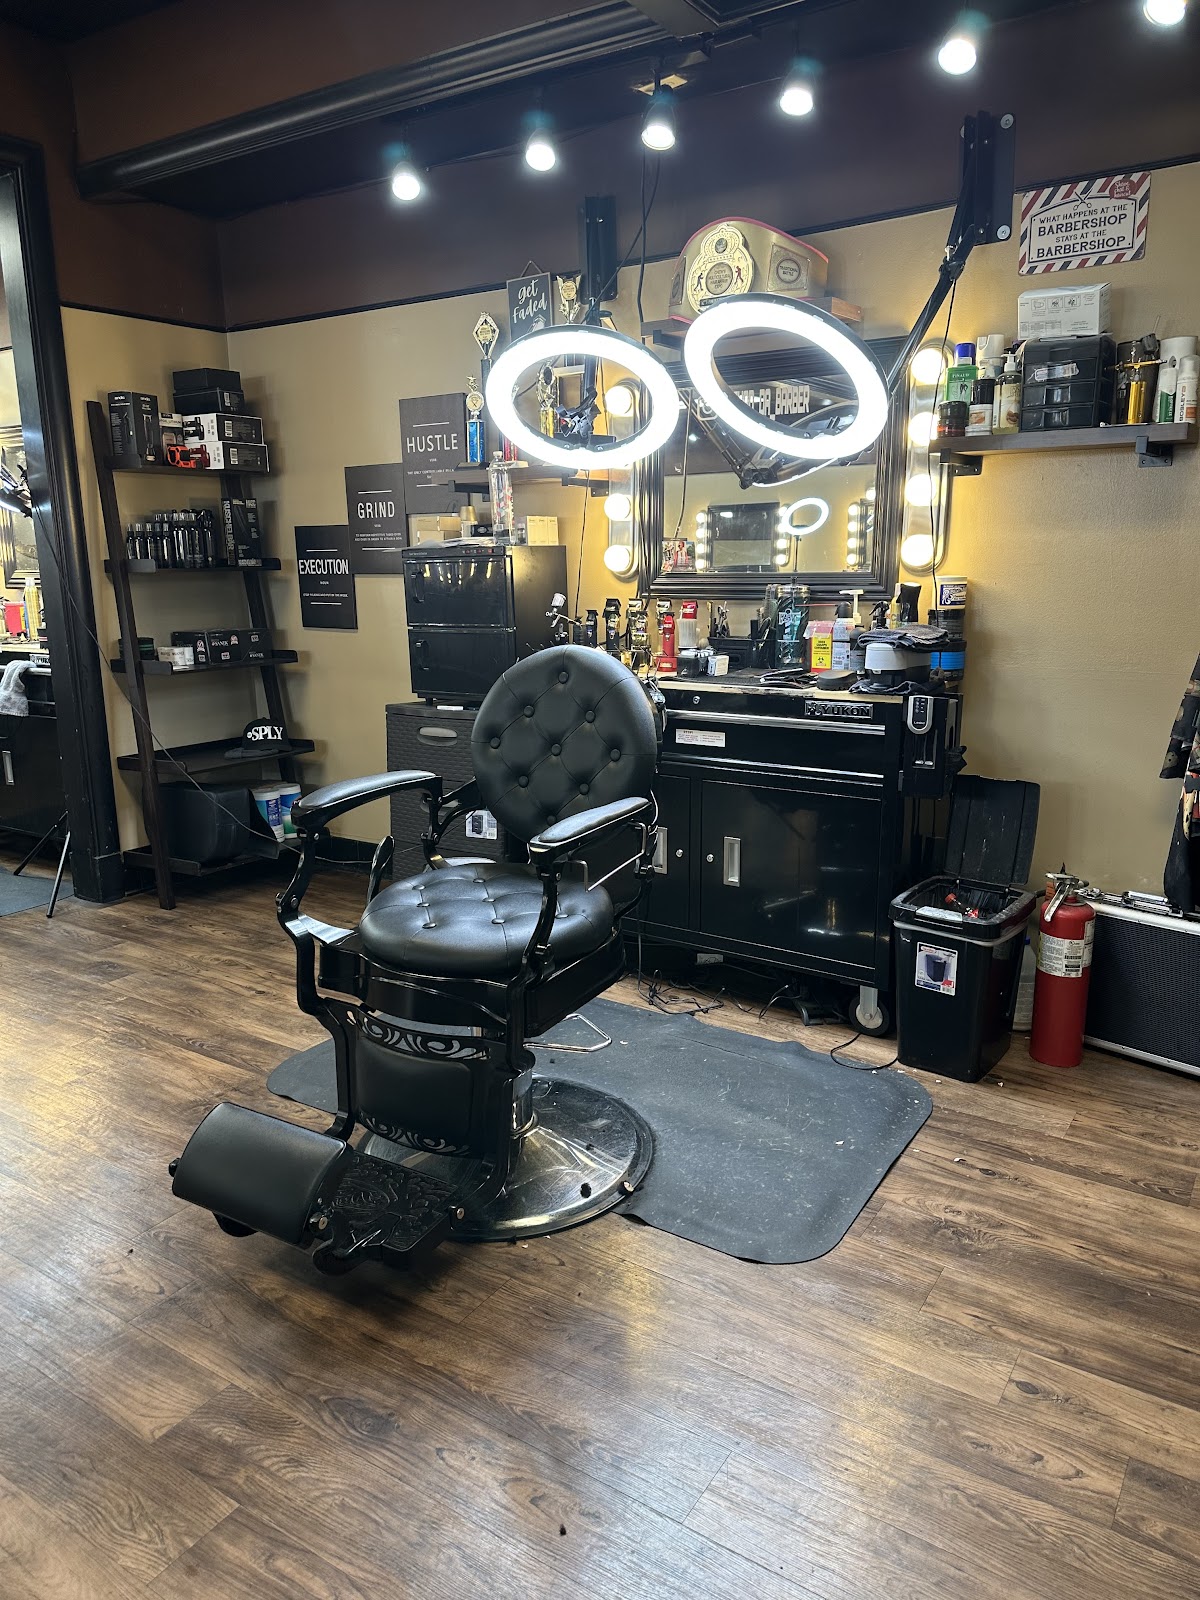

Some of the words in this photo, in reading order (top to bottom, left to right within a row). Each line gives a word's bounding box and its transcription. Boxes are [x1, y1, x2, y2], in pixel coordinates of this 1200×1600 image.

[1039, 214, 1061, 224] WHAT
[1062, 208, 1098, 221] HAPPENS
[1100, 206, 1110, 214] AT
[1112, 203, 1128, 212] THE
[1038, 213, 1128, 237] BARBERSHOP
[1055, 233, 1078, 243] STAYS
[1079, 232, 1090, 240] AT
[1091, 229, 1107, 238] THE
[1036, 235, 1126, 259] BARBERSHOP
[518, 279, 538, 305] get
[406, 433, 459, 453] HUSTLE
[357, 501, 395, 519] GRIND
[298, 559, 349, 574] EXECUTION
[821, 703, 871, 716] YUKON
